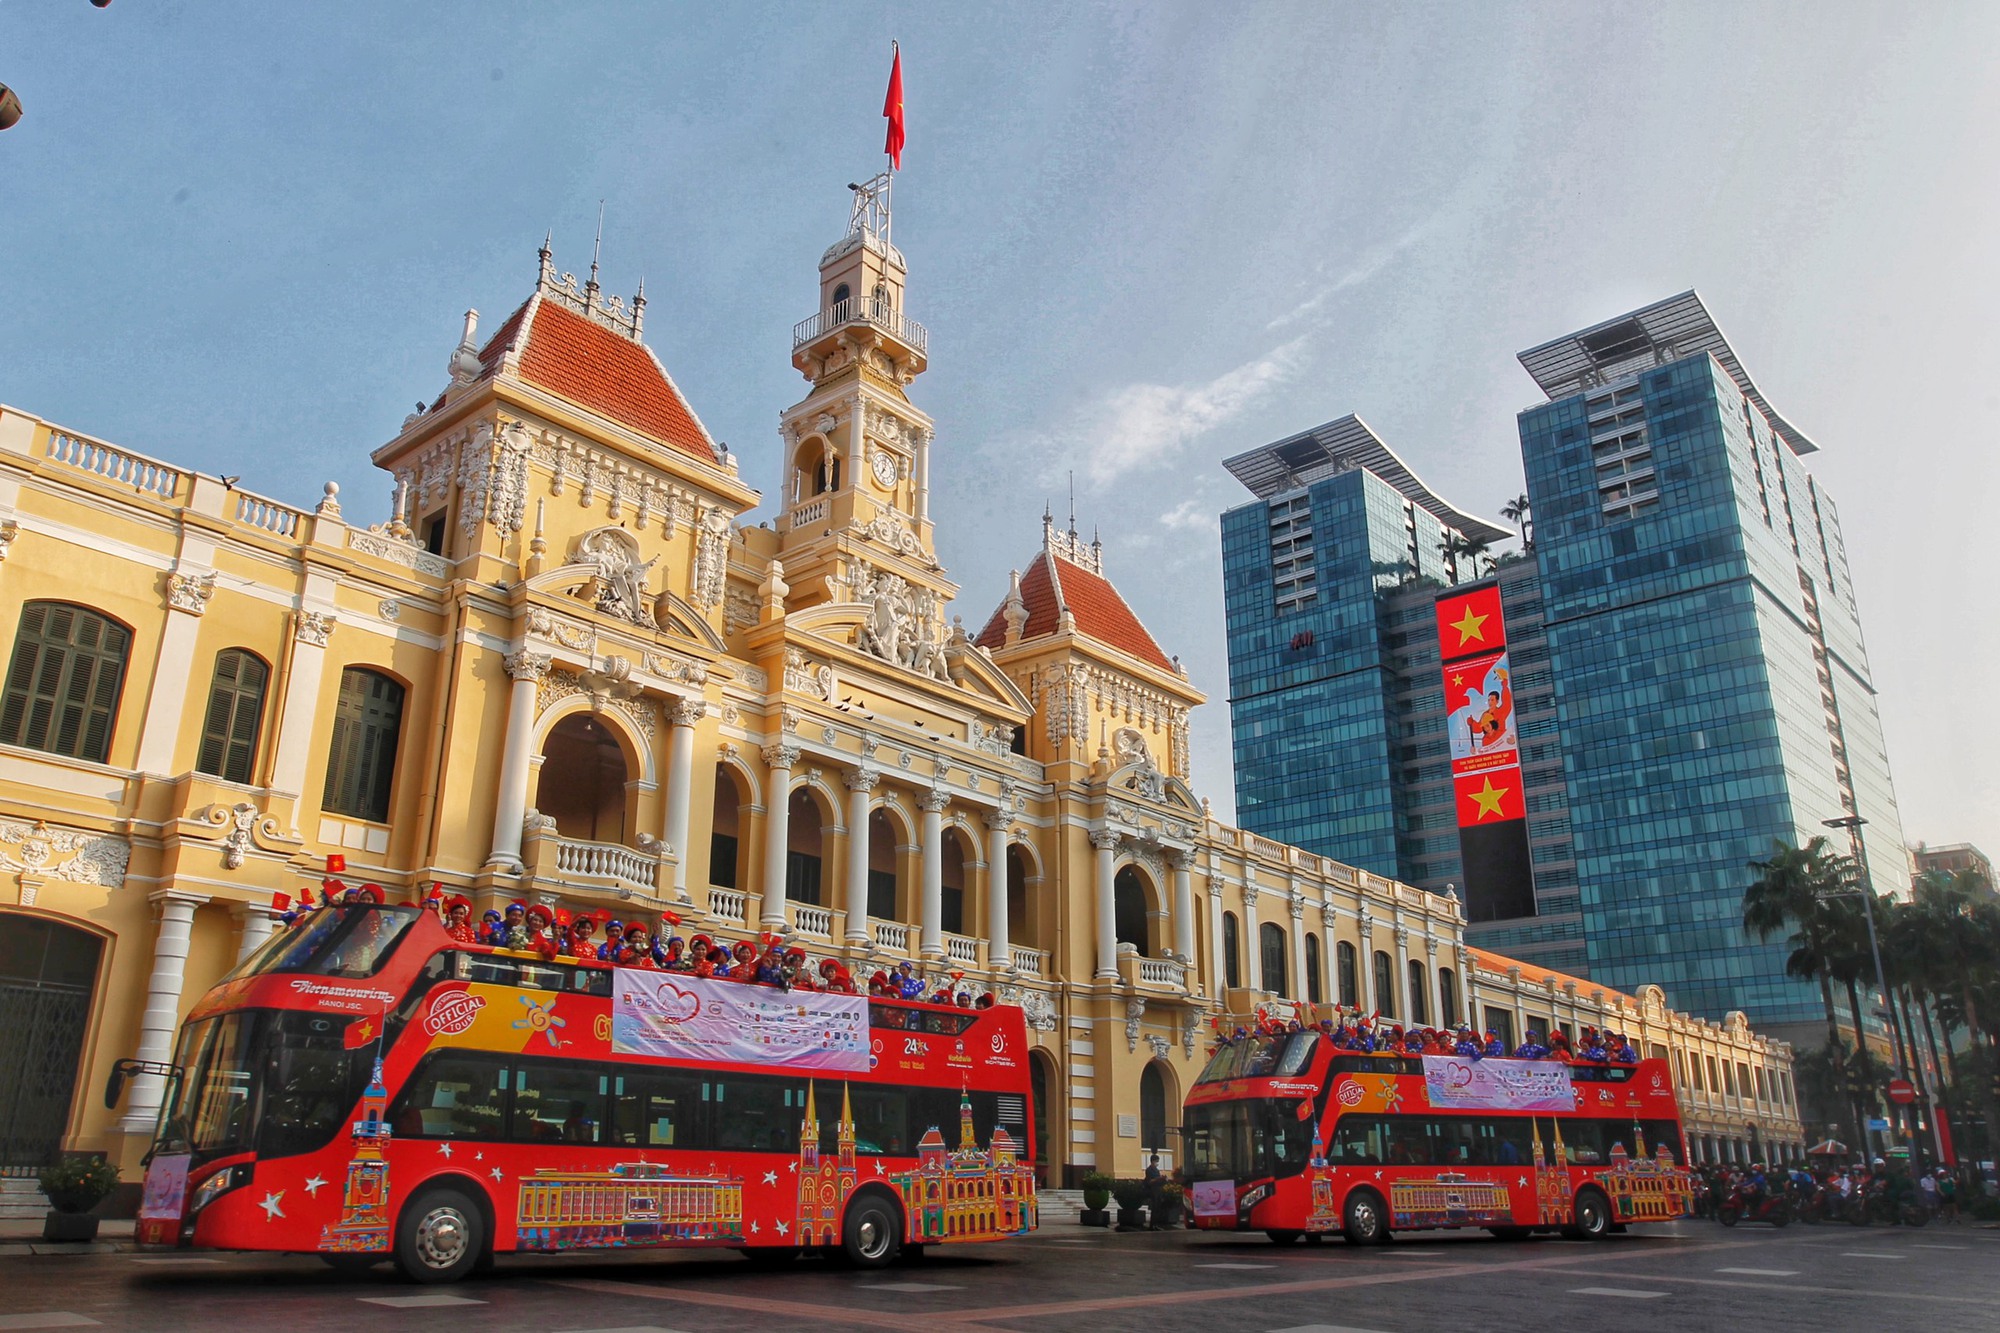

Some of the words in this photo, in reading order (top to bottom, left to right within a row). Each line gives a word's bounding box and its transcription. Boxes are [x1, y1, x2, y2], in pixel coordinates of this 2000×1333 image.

[290, 980, 395, 1003] Vietnamtourism
[318, 1000, 345, 1008] HANOI
[431, 998, 484, 1030] OFFICIAL
[450, 1015, 474, 1031] TOUR
[1339, 1086, 1365, 1101] OFFICIAL
